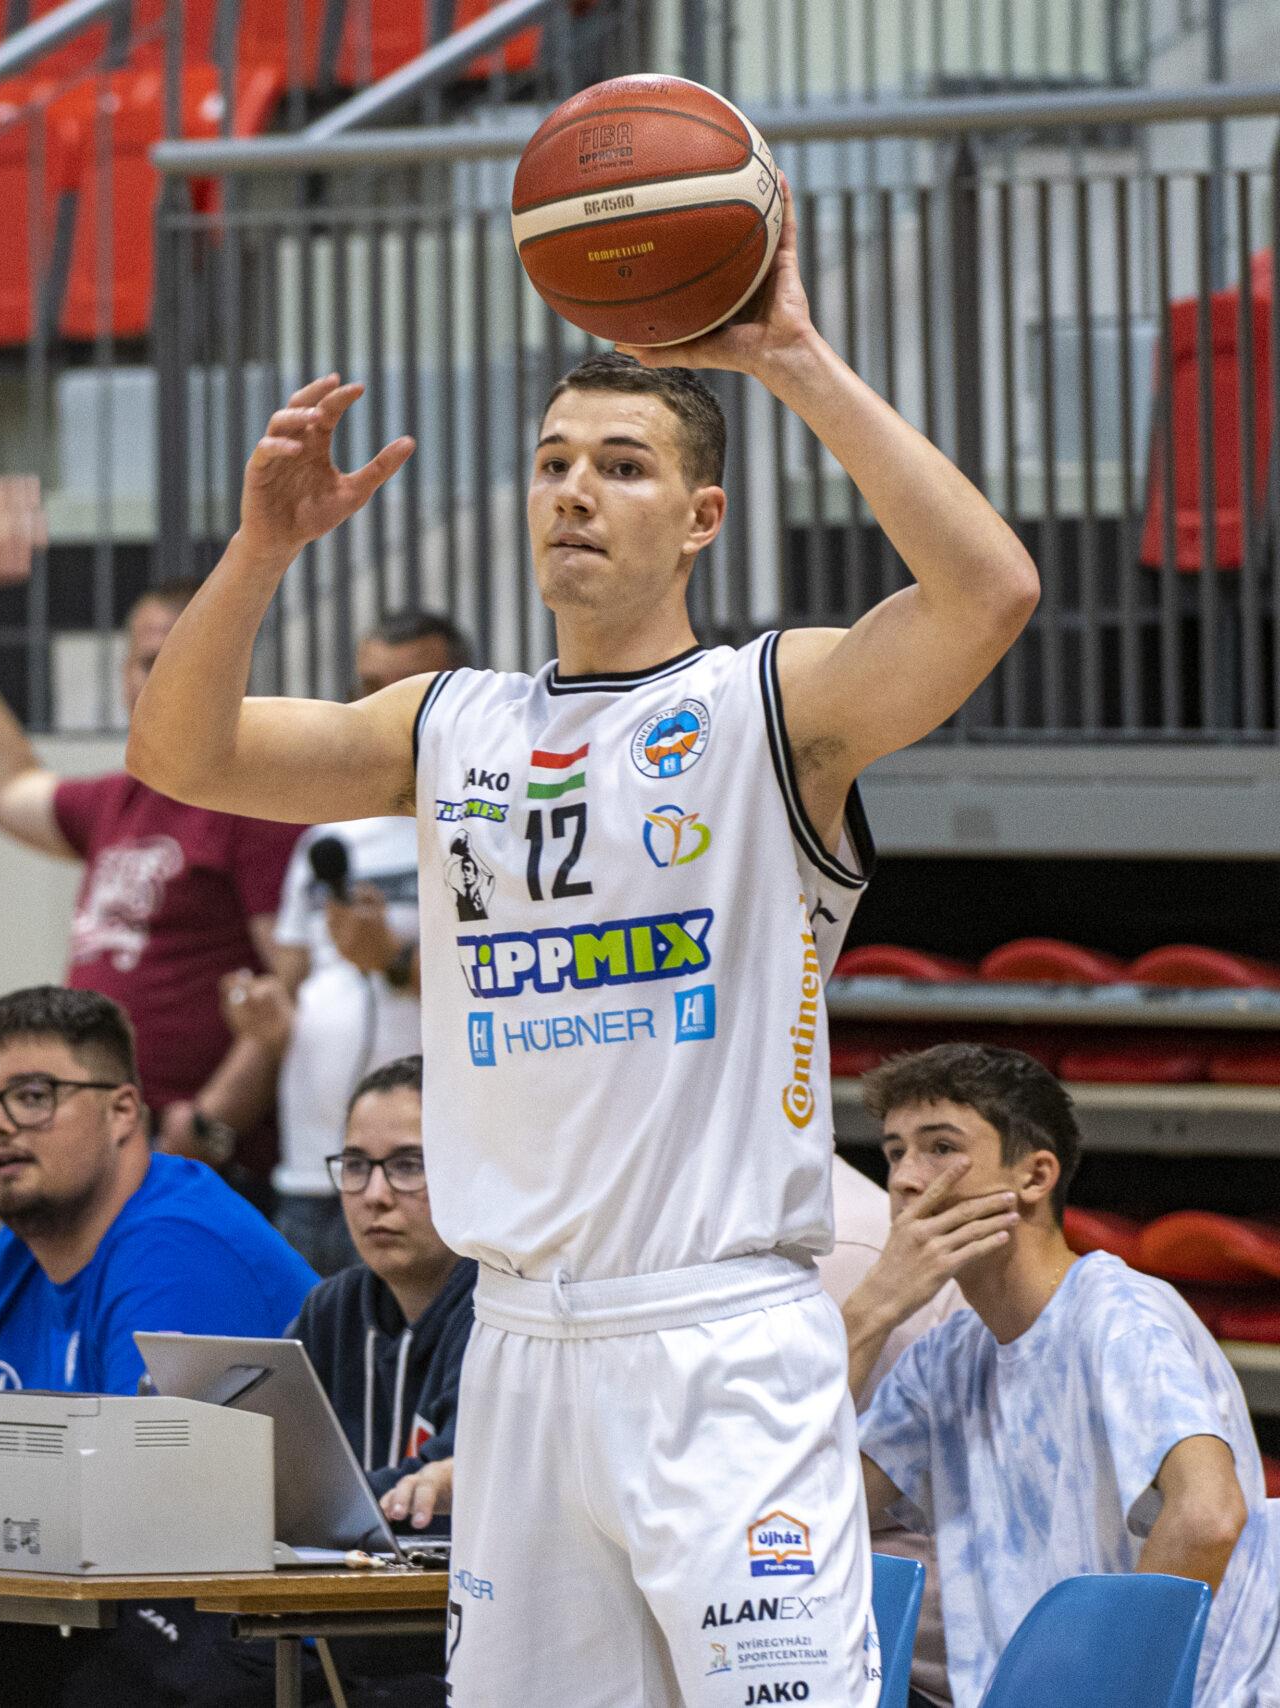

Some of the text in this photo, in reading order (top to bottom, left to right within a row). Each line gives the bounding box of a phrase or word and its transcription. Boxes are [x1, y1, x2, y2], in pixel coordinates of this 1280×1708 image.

[578, 122, 633, 153] FIBA
[578, 146, 633, 165] APPROVED
[583, 194, 634, 216] BG4500
[587, 241, 654, 261] COMPETITION
[463, 767, 510, 792] AKO
[524, 802, 593, 901] 12
[503, 1007, 656, 1054] HÜBNER
[758, 1531, 802, 1547] újház
[701, 1597, 814, 1629] ALANEX
[737, 1635, 812, 1650] NYÍREGYHÁZI
[738, 1649, 828, 1663] SPORTCENTRUM
[745, 1680, 809, 1706] JAKO
